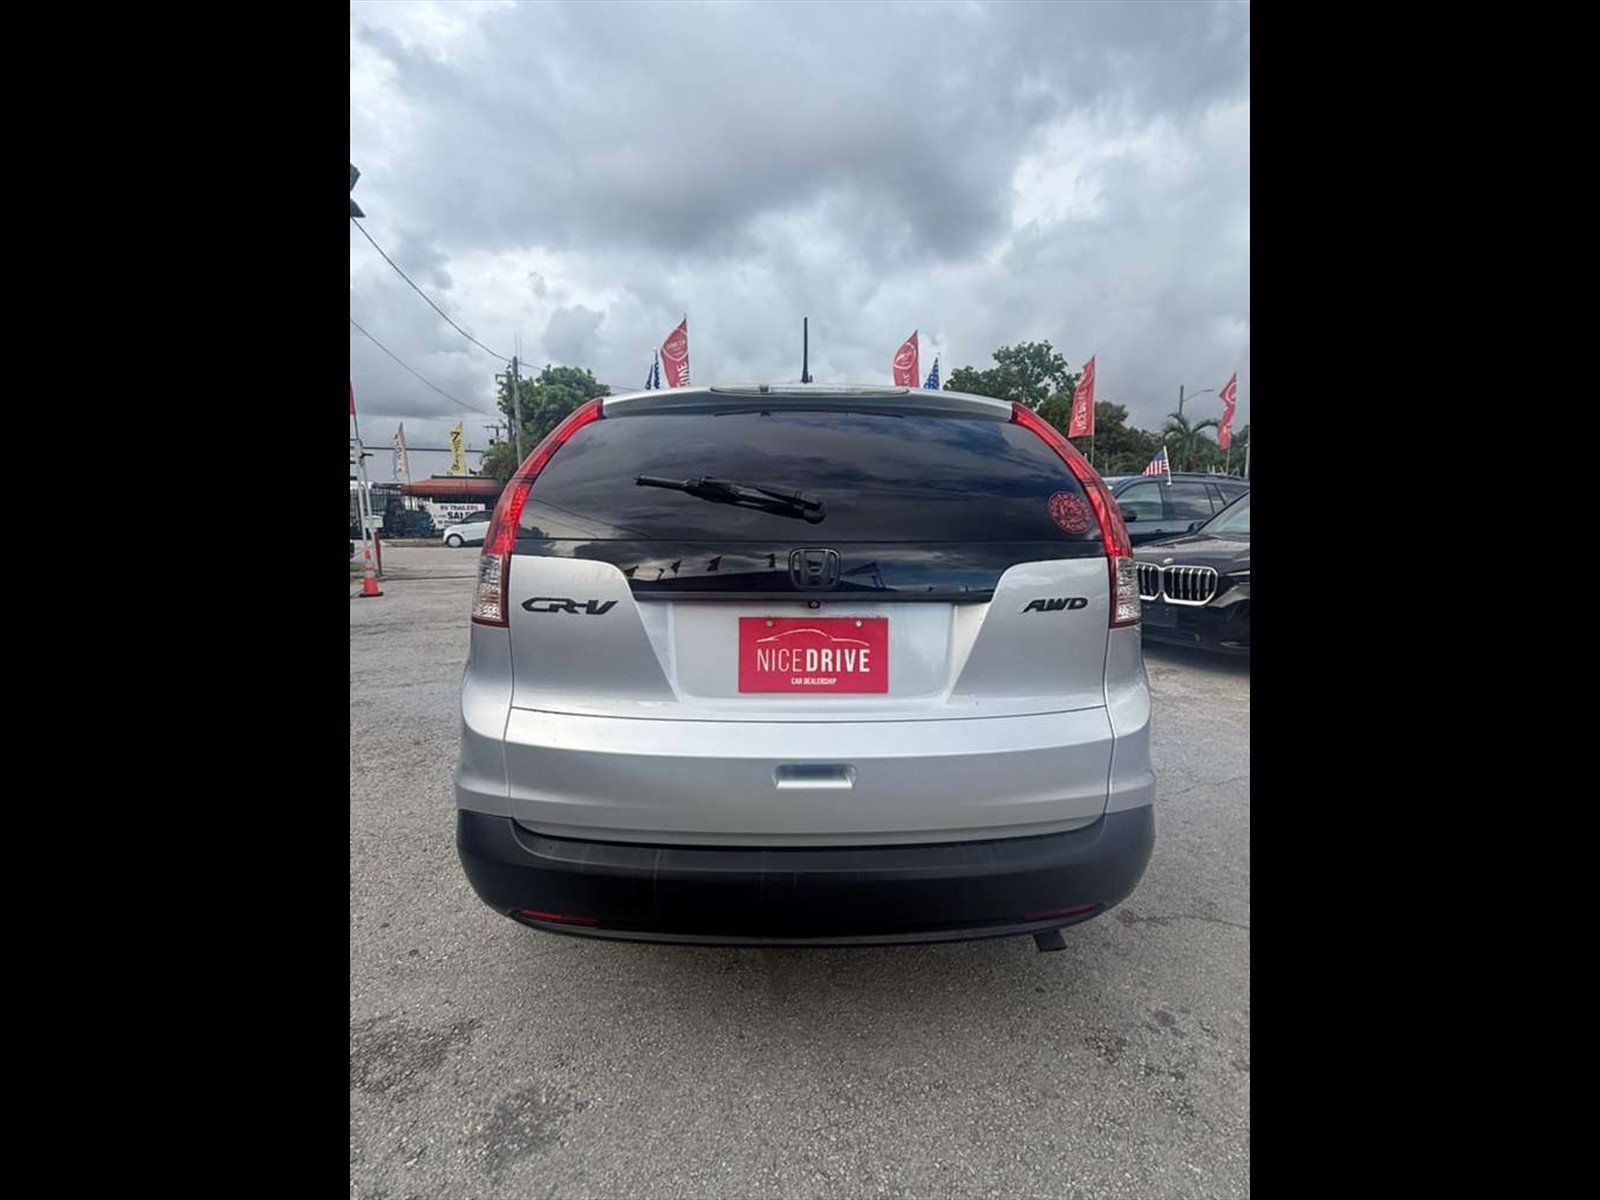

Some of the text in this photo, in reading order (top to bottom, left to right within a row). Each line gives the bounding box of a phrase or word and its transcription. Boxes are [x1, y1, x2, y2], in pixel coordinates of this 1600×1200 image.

[521, 597, 618, 615] CR-V
[1022, 597, 1088, 612] AWD
[790, 677, 837, 685] CAR DEALERSHIP
